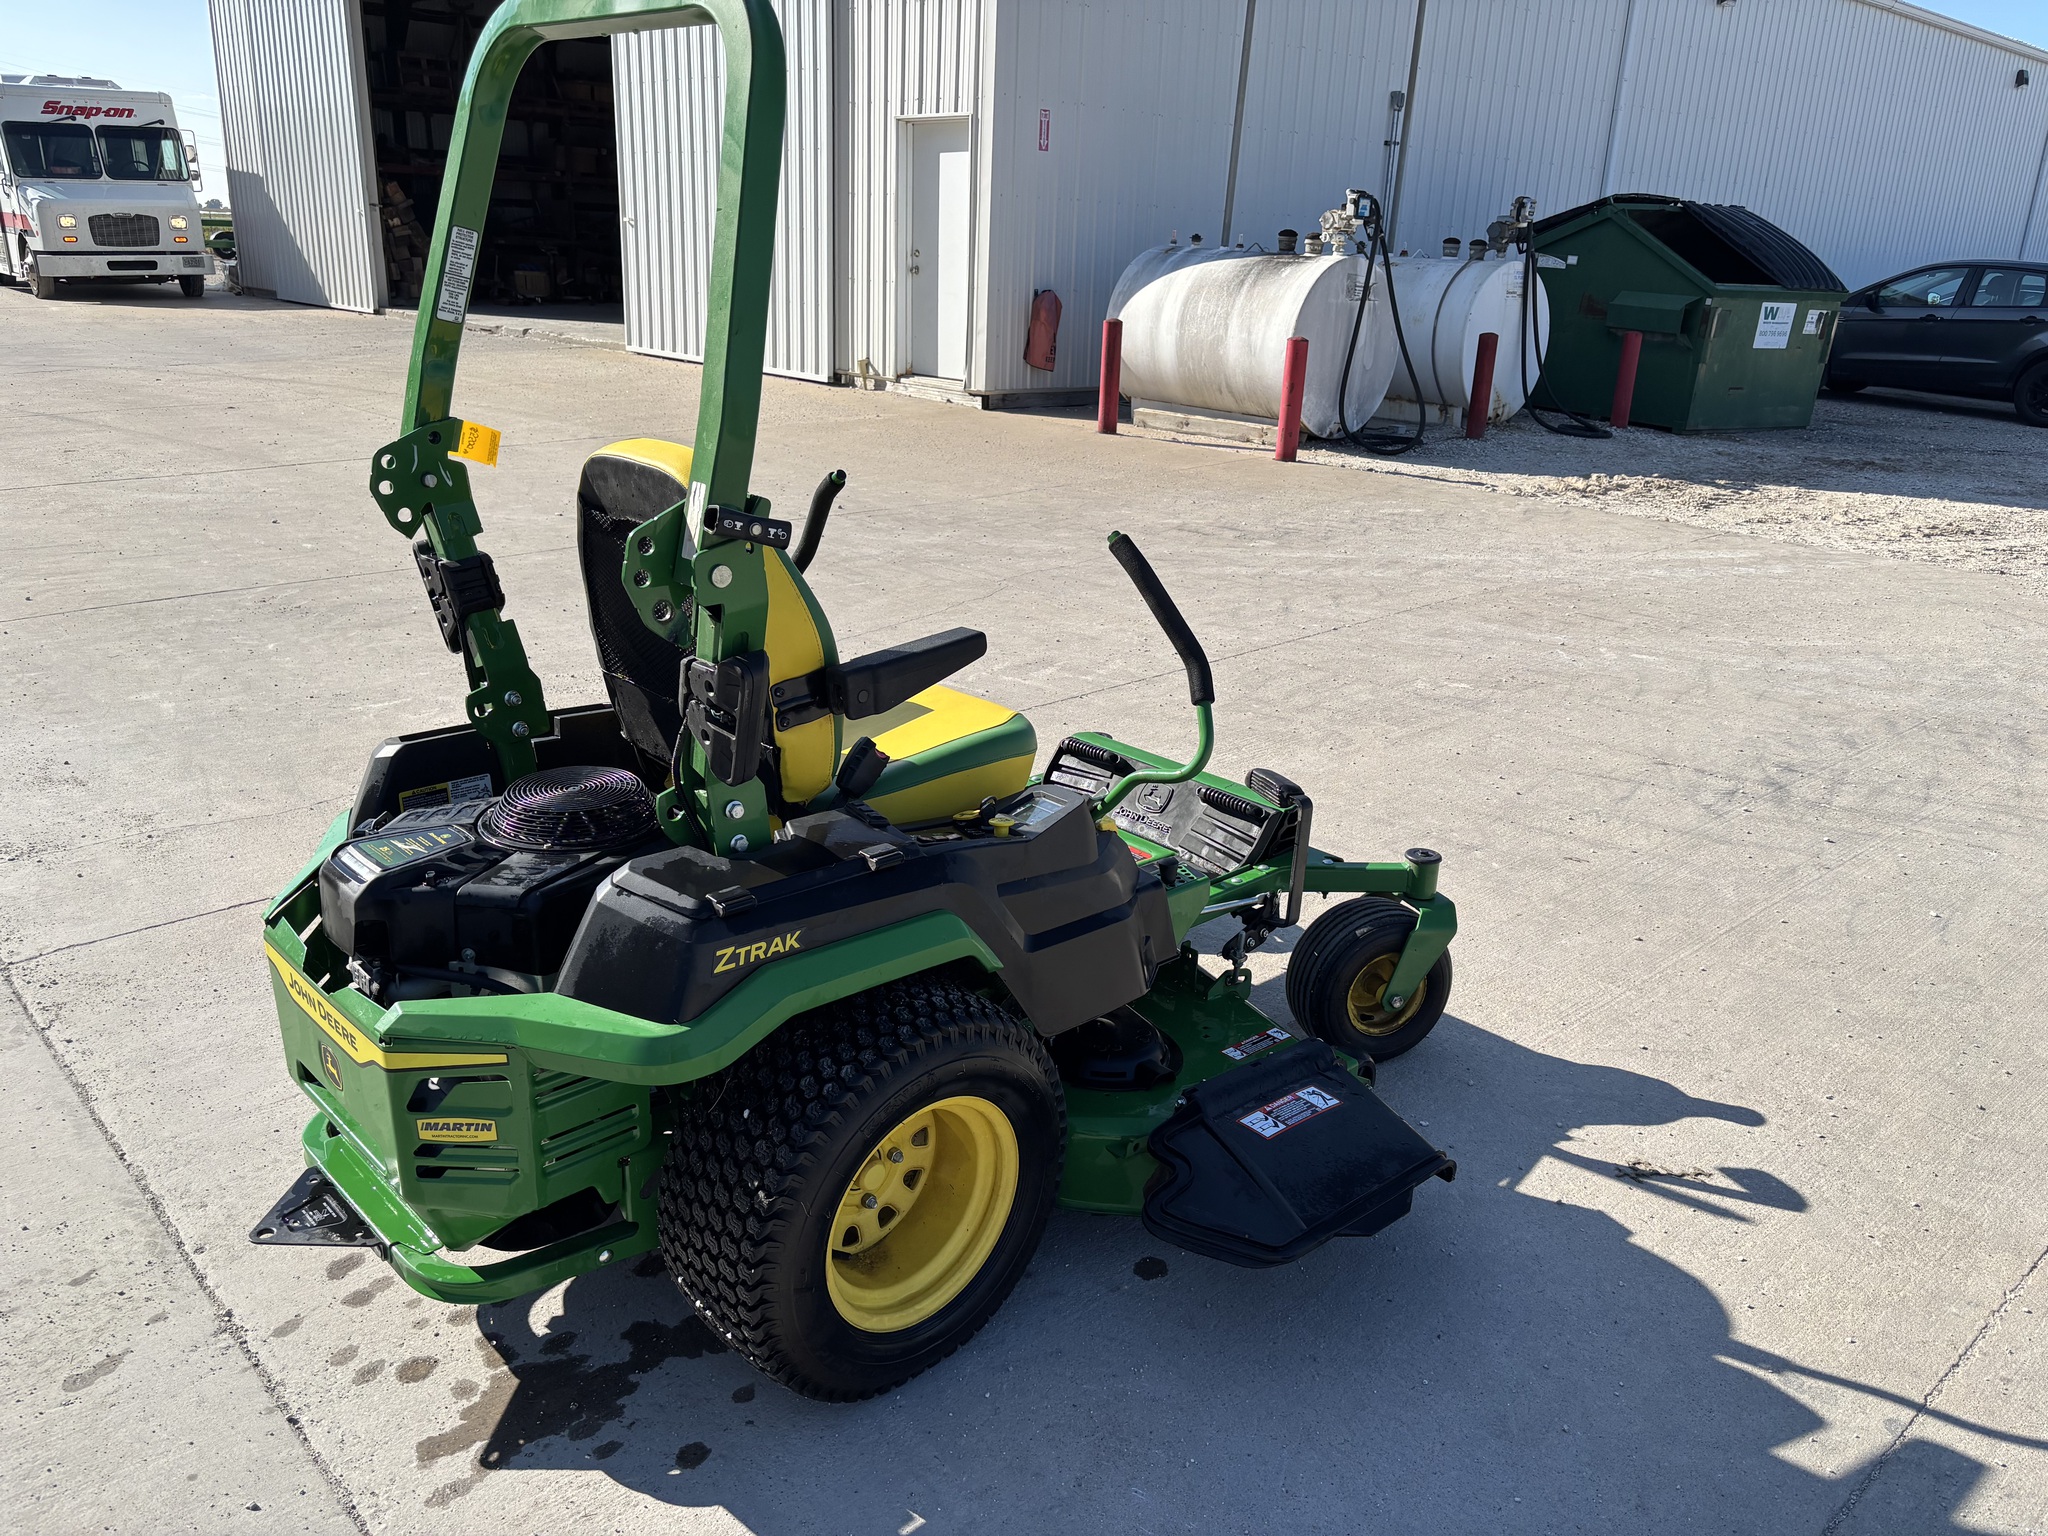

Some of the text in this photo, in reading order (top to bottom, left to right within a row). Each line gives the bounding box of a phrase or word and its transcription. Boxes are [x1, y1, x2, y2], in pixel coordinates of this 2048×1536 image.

[41, 100, 134, 119] Snap-on
[1115, 805, 1172, 834] JOHN DEERE
[713, 930, 801, 974] ZTRAK
[289, 972, 358, 1052] JOHN DEERE
